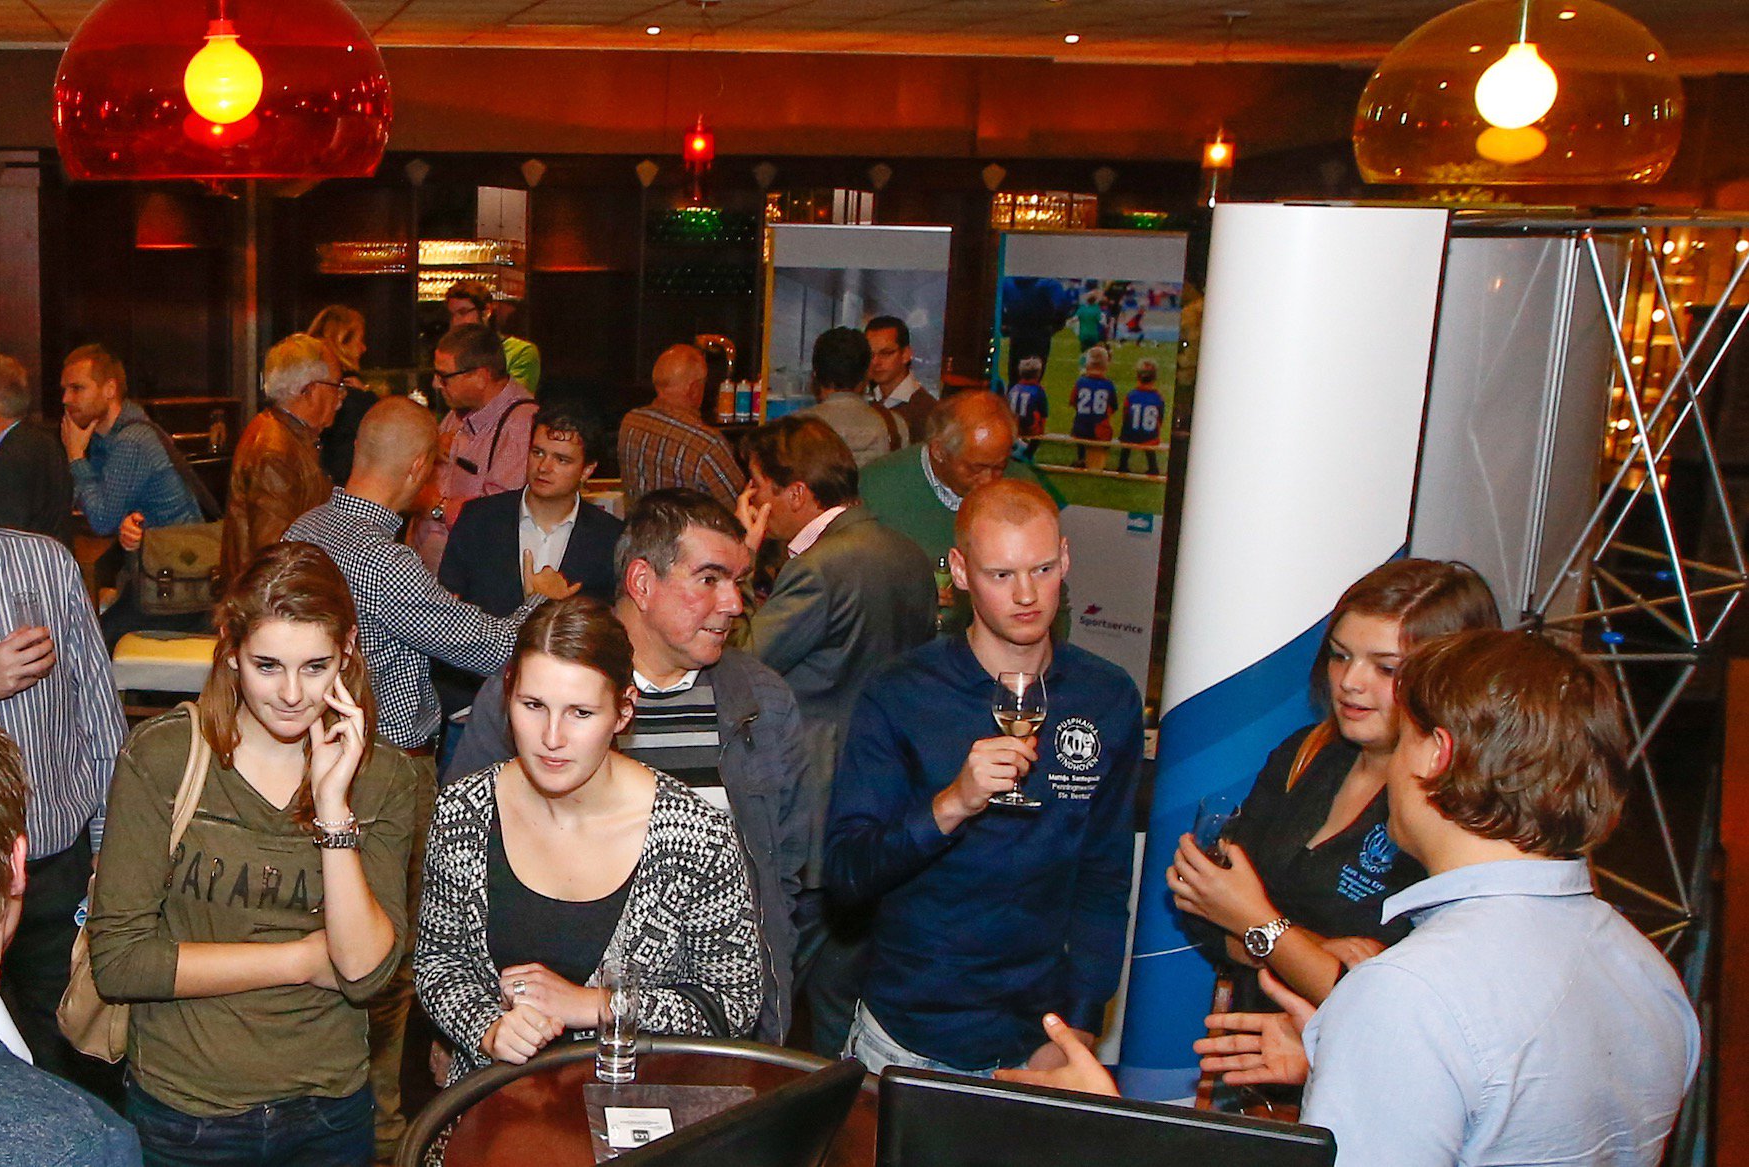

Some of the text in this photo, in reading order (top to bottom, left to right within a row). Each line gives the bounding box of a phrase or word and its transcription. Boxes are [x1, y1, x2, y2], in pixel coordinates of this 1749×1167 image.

[1079, 615, 1144, 634] Sportservice
[1055, 752, 1099, 772] EINDHOVEN
[164, 842, 324, 915] PAPARA
